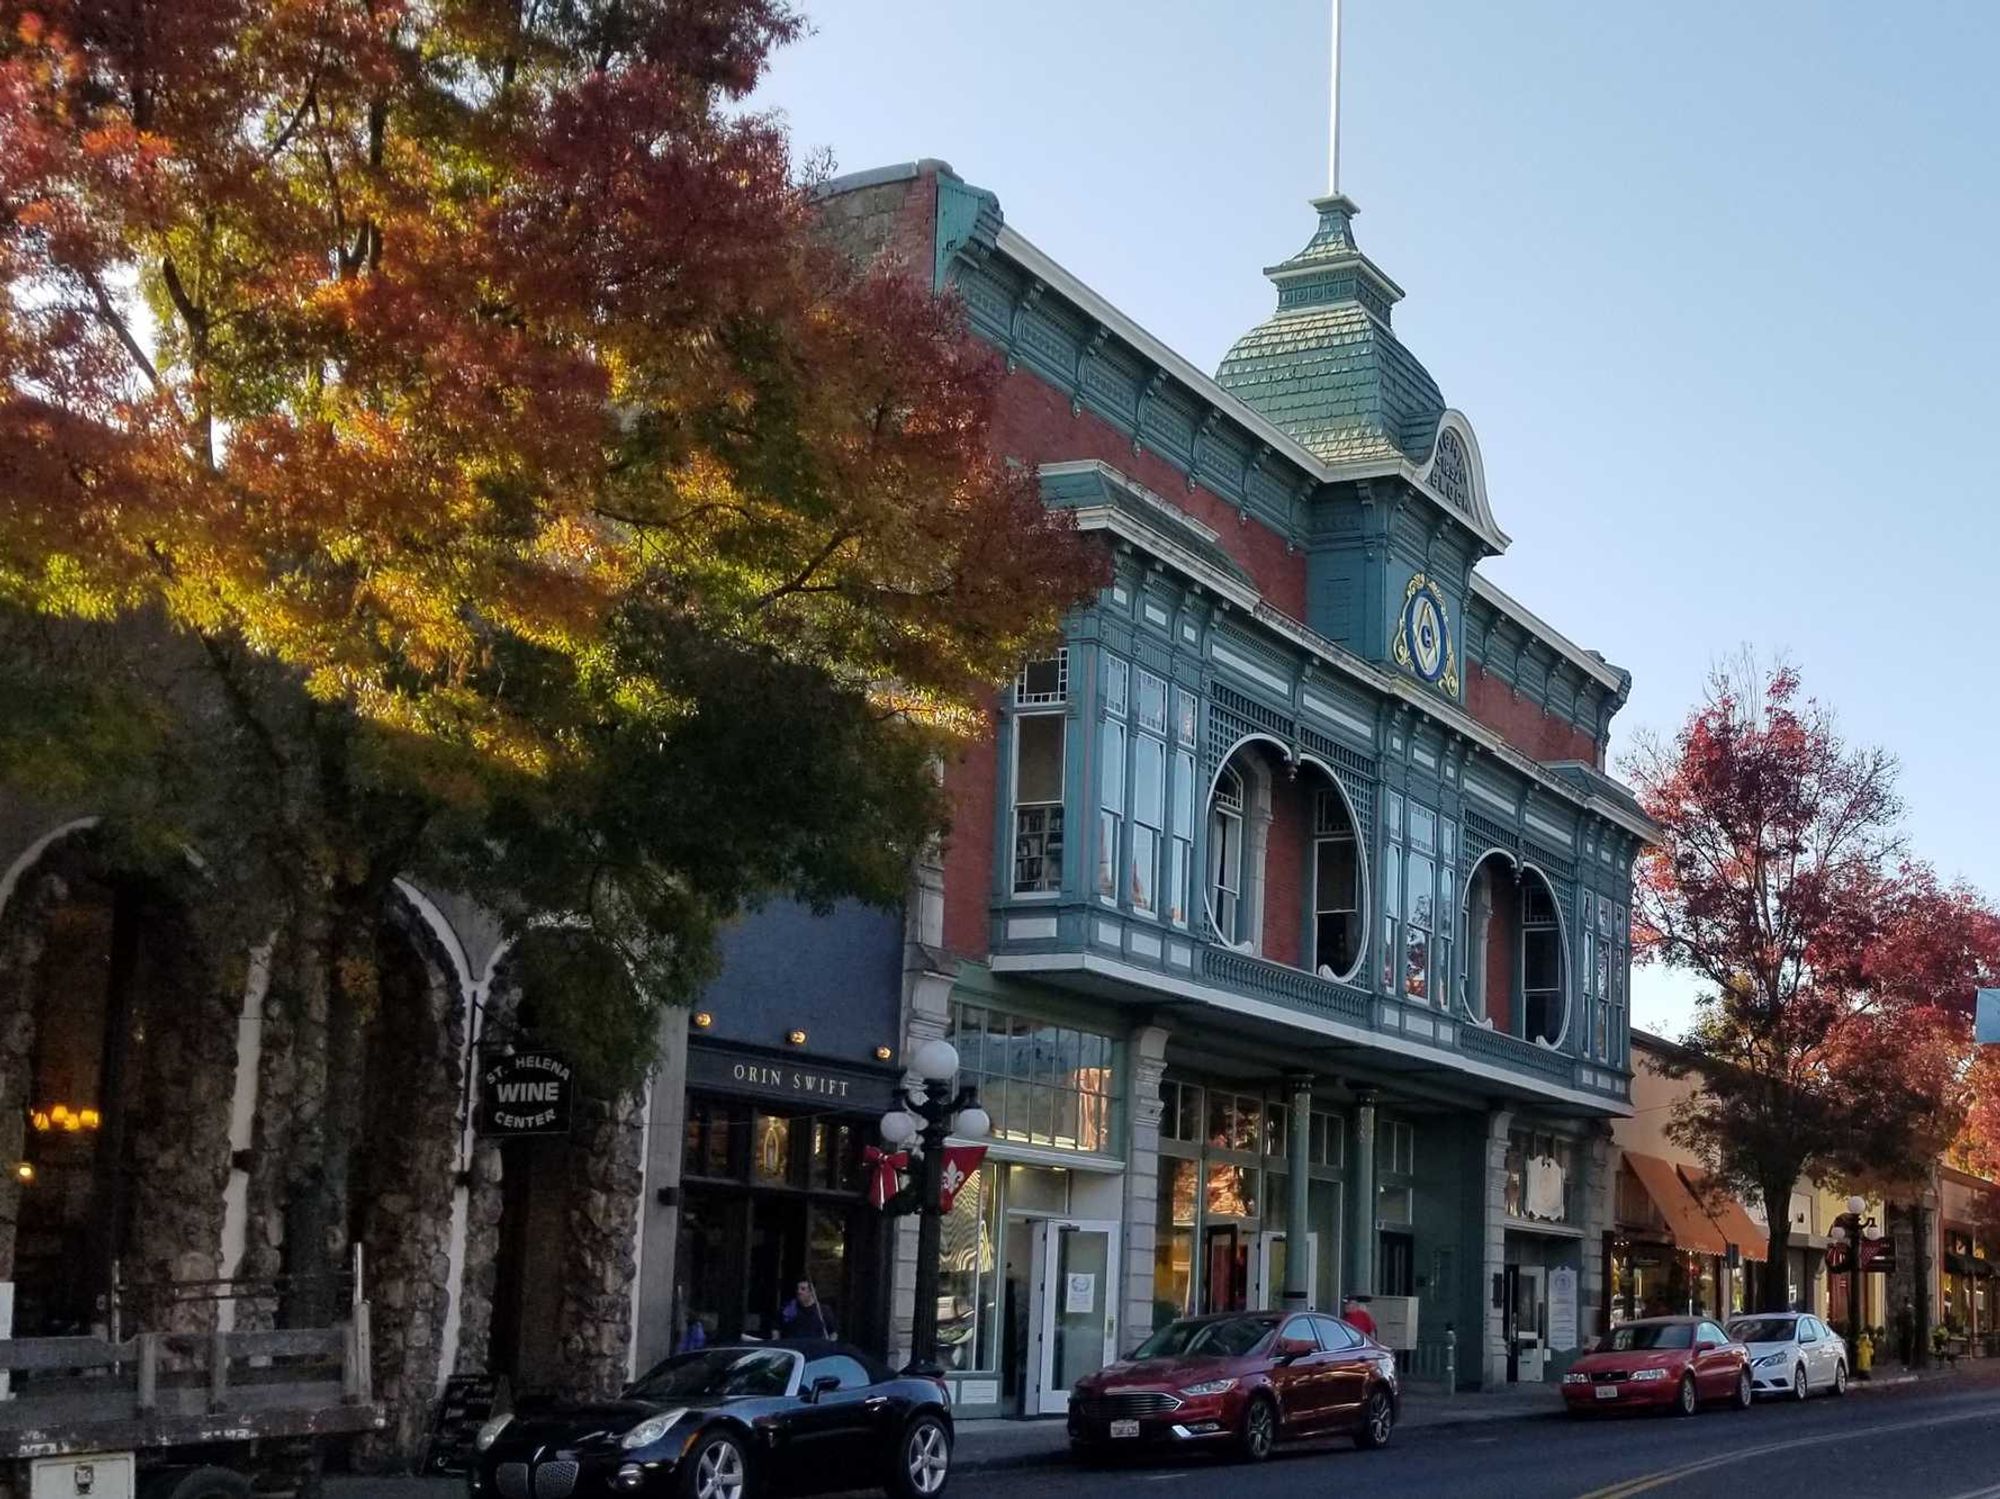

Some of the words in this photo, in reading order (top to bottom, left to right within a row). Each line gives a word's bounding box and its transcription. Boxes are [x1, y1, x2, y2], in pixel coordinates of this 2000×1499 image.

[486, 1065, 509, 1084] ST.
[515, 1055, 571, 1081] HELENA
[734, 1064, 781, 1087] ORIN
[793, 1073, 849, 1097] SWIFT
[496, 1081, 560, 1103] WINE
[494, 1108, 556, 1129] CENTER
